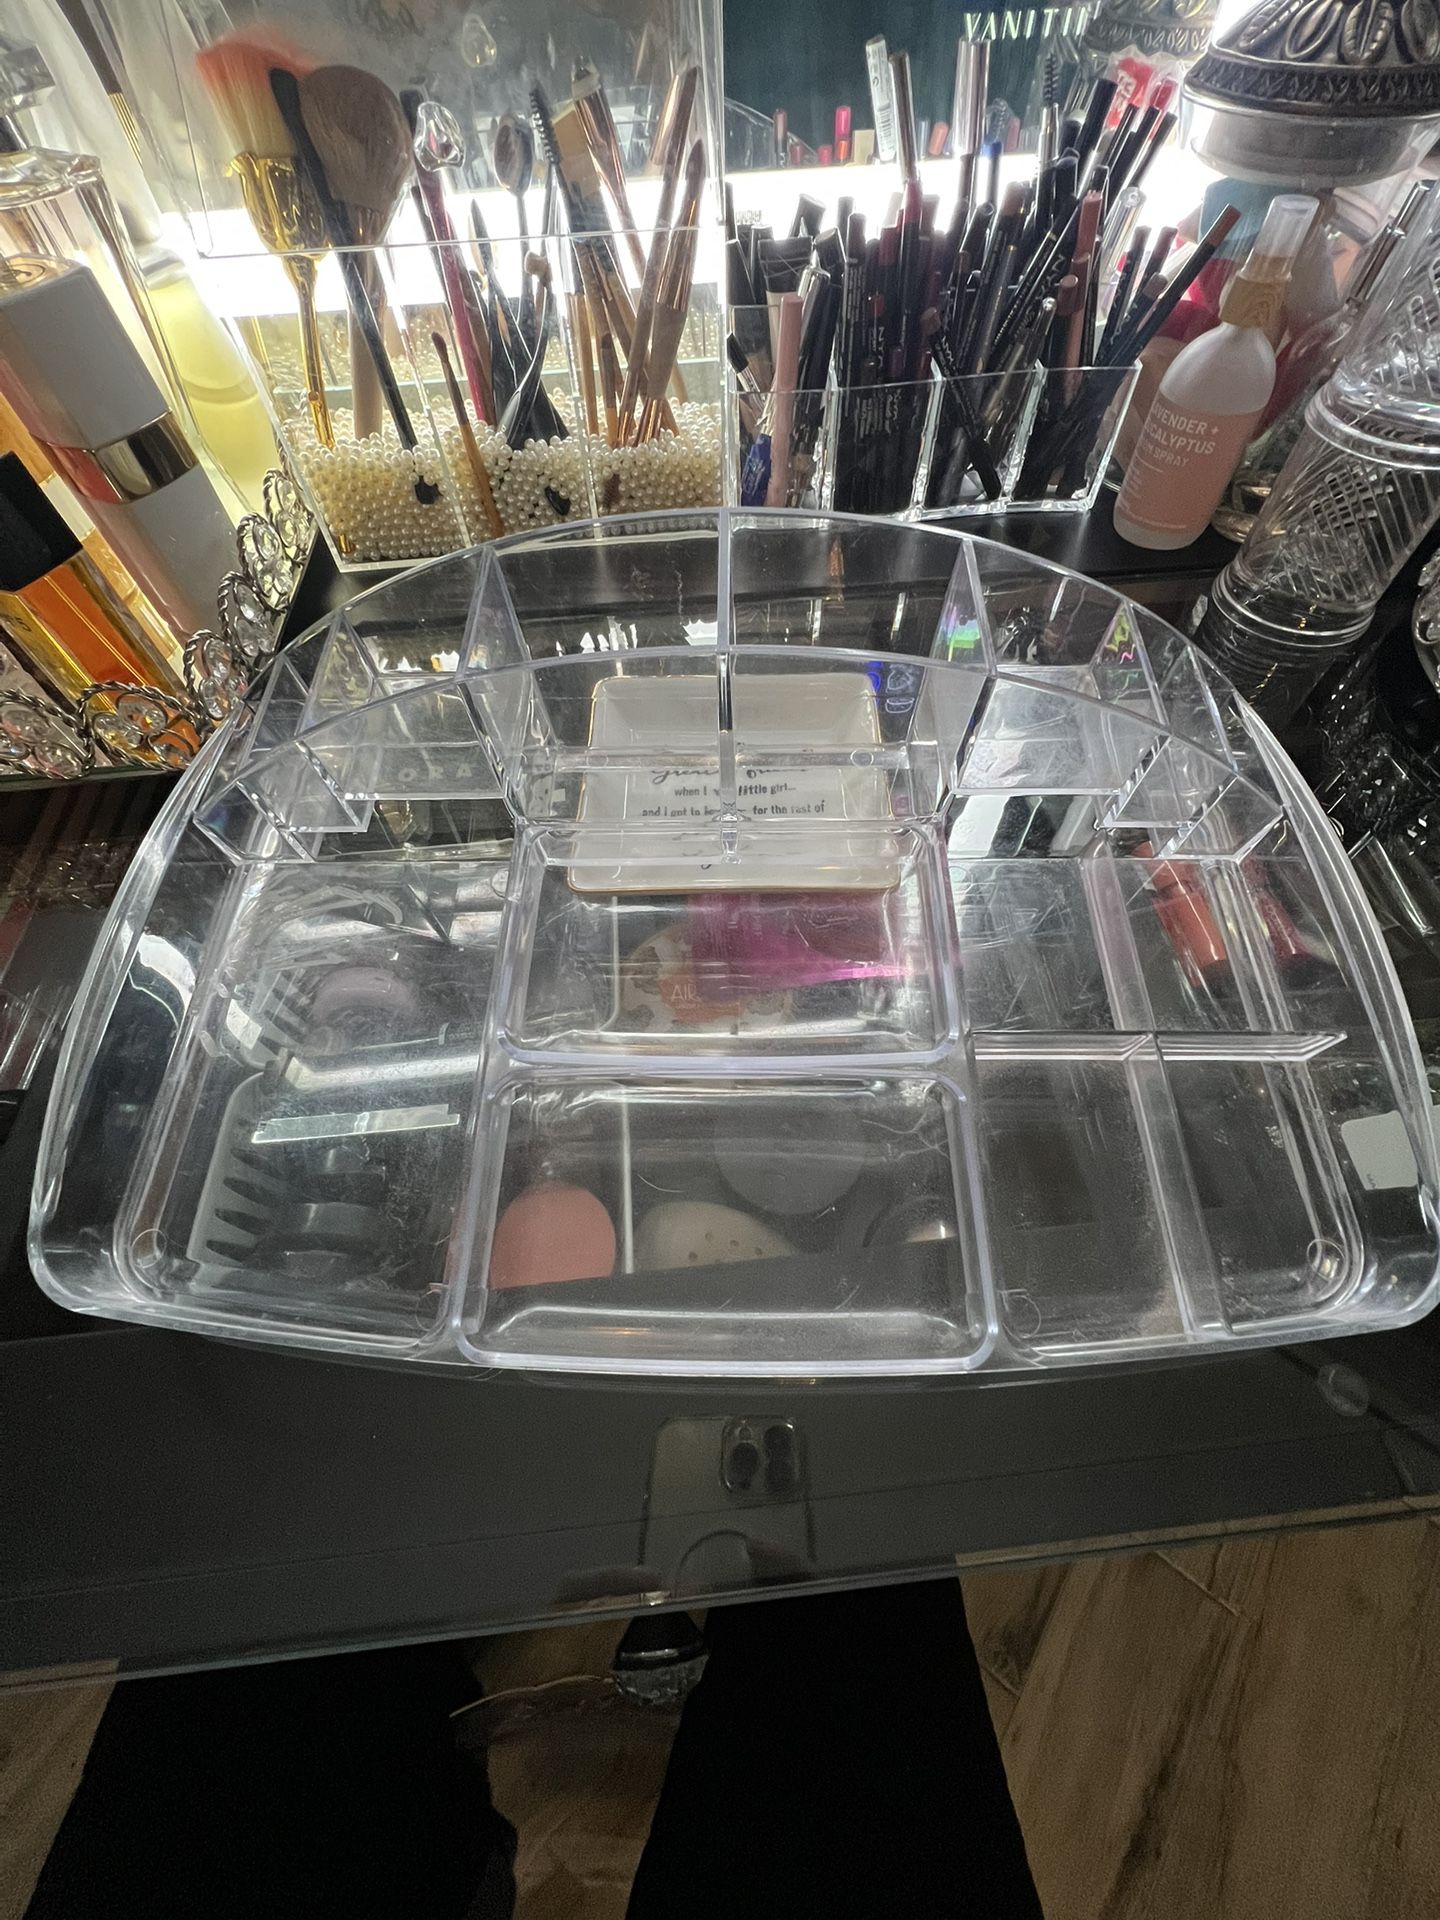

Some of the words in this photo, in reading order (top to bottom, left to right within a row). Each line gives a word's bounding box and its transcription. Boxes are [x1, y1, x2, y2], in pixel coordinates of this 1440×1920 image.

[674, 785, 700, 796] when
[642, 806, 661, 817] and
[753, 804, 768, 815] for
[814, 799, 825, 813] of
